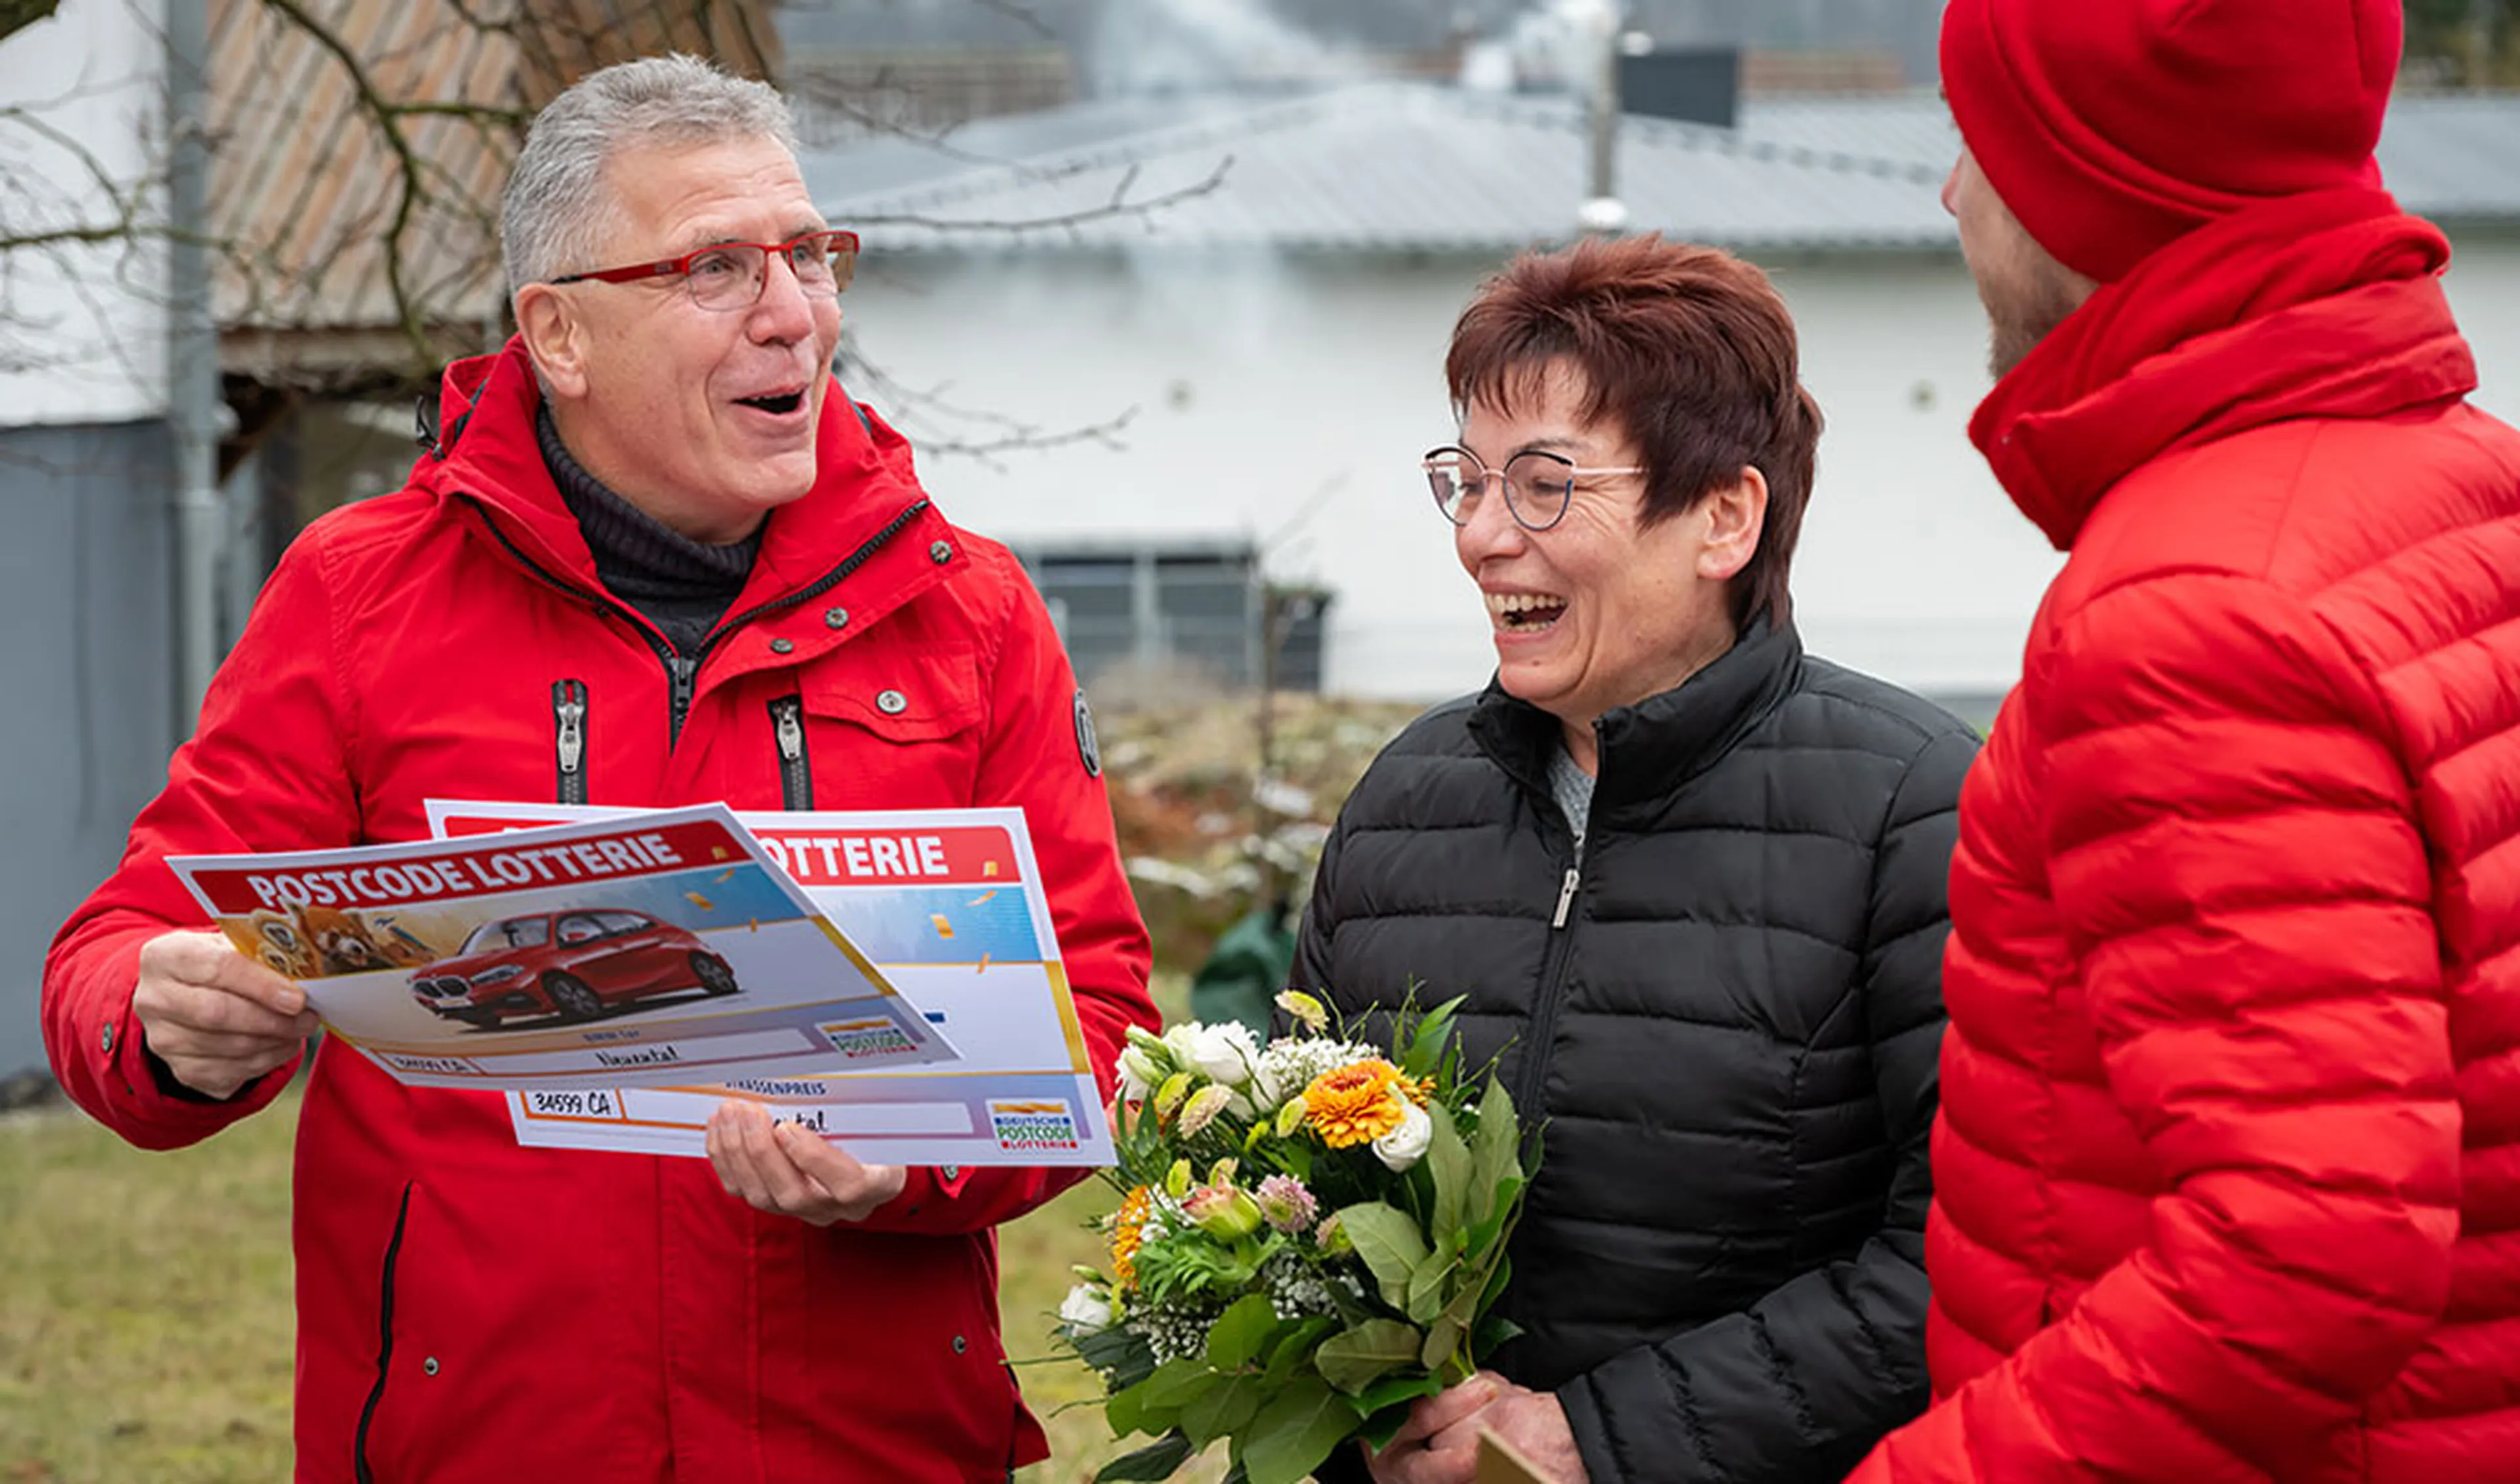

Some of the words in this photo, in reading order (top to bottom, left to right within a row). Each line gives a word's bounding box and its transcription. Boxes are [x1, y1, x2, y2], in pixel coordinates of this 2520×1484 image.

[246, 860, 472, 908] POSTCODE
[463, 833, 683, 887] LOTTERIE
[760, 836, 949, 877] OTTERIE
[536, 1091, 583, 1113] 34599
[588, 1092, 612, 1115] CA
[998, 1126, 1072, 1140] POSTCODE
